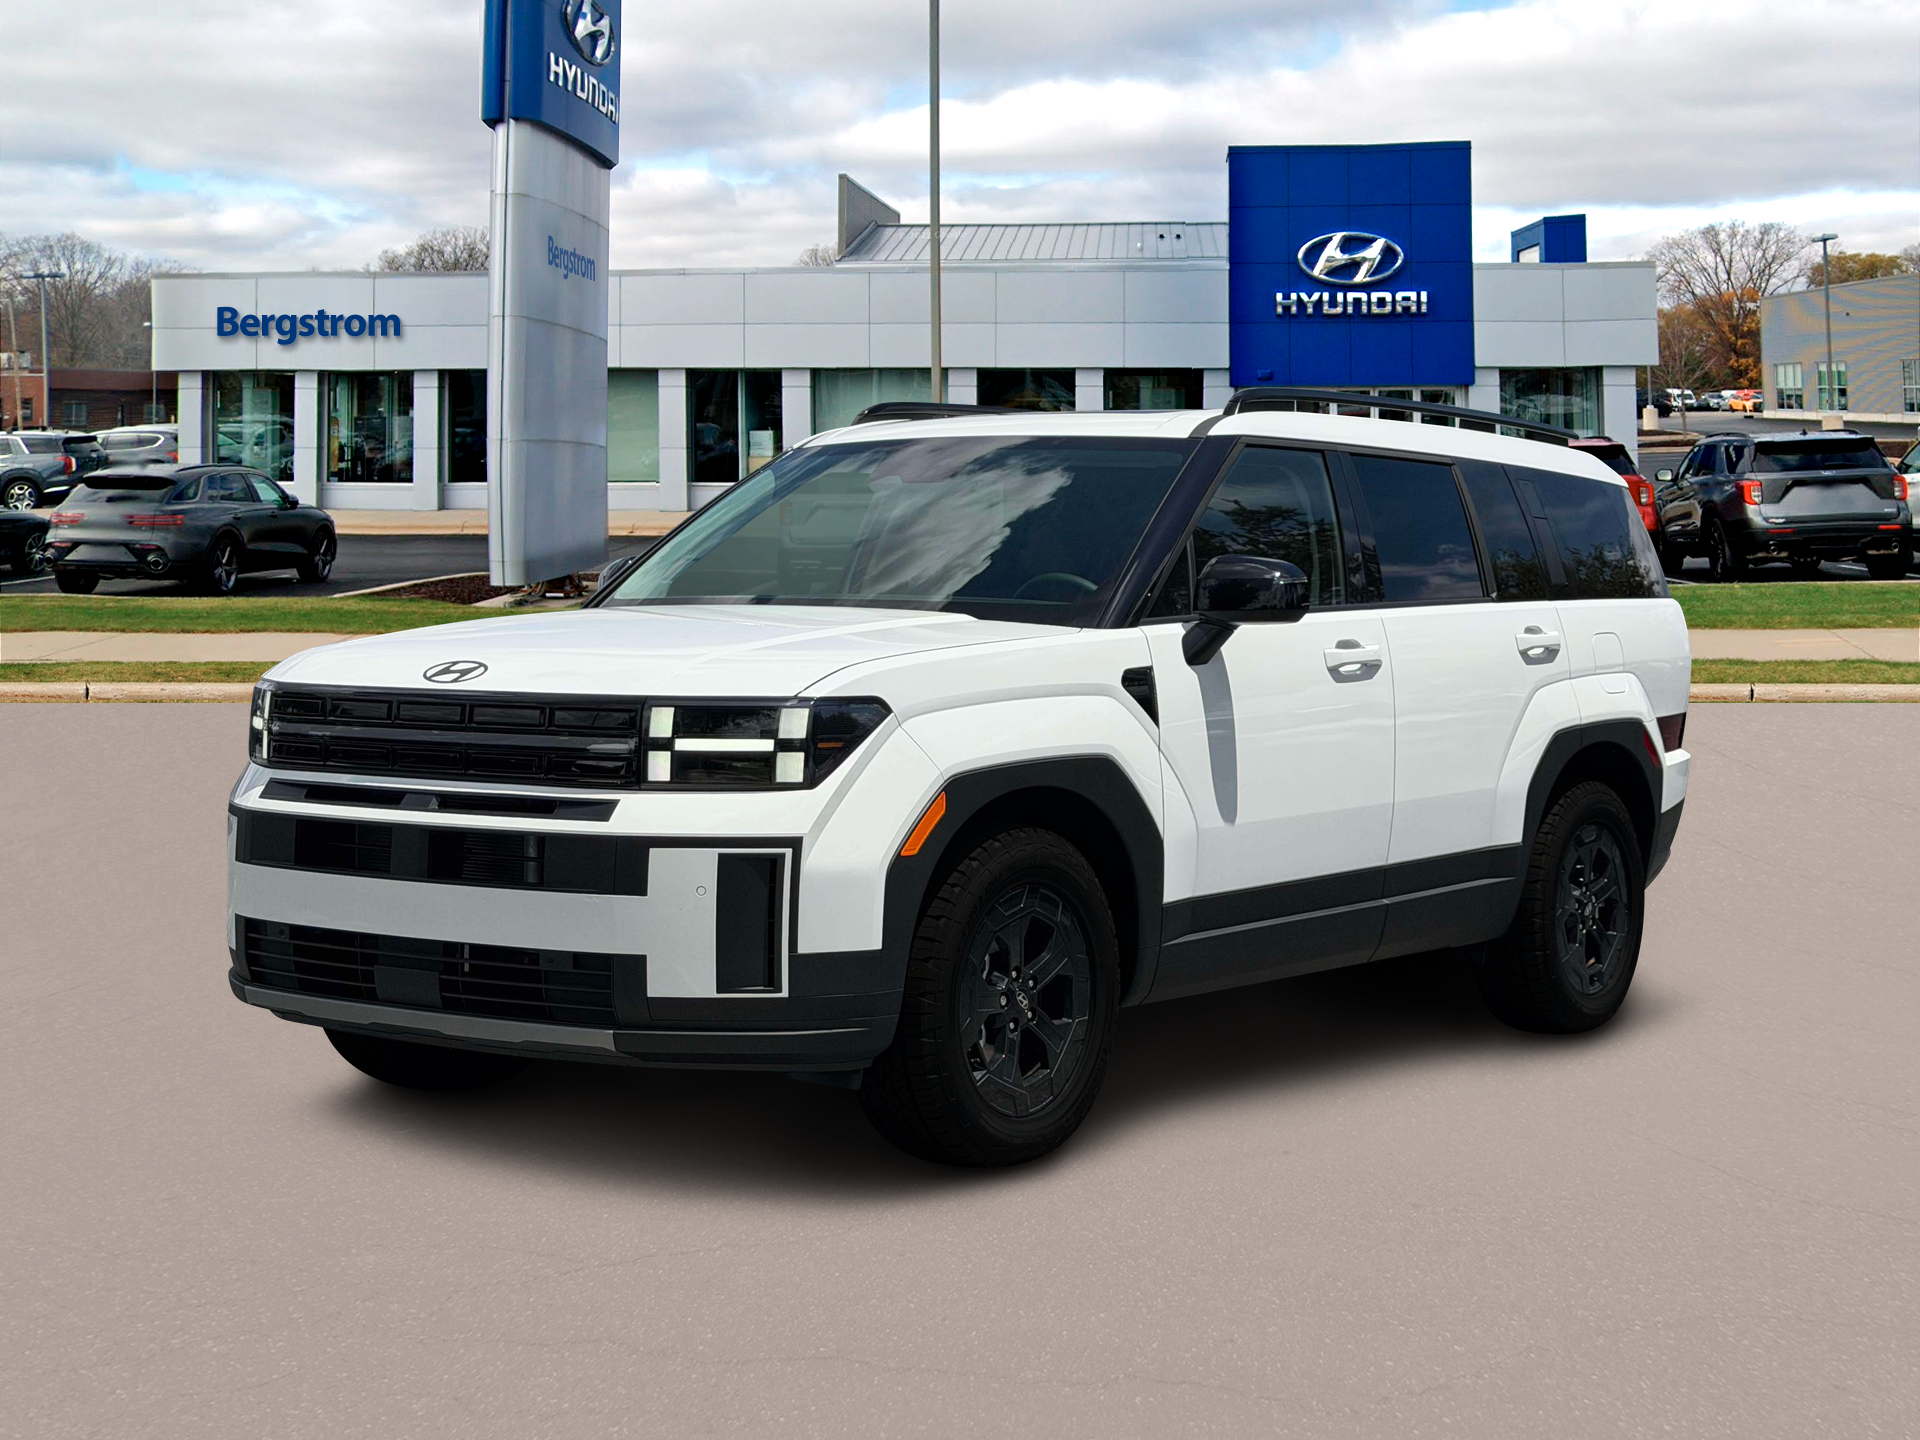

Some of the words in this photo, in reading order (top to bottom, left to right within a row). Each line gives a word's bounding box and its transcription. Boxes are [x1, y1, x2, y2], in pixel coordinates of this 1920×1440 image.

[549, 52, 619, 124] HYUNDAI
[548, 235, 596, 282] Bergstrom
[1275, 291, 1428, 315] HYUNDAI
[216, 306, 401, 346] Bergstrom
